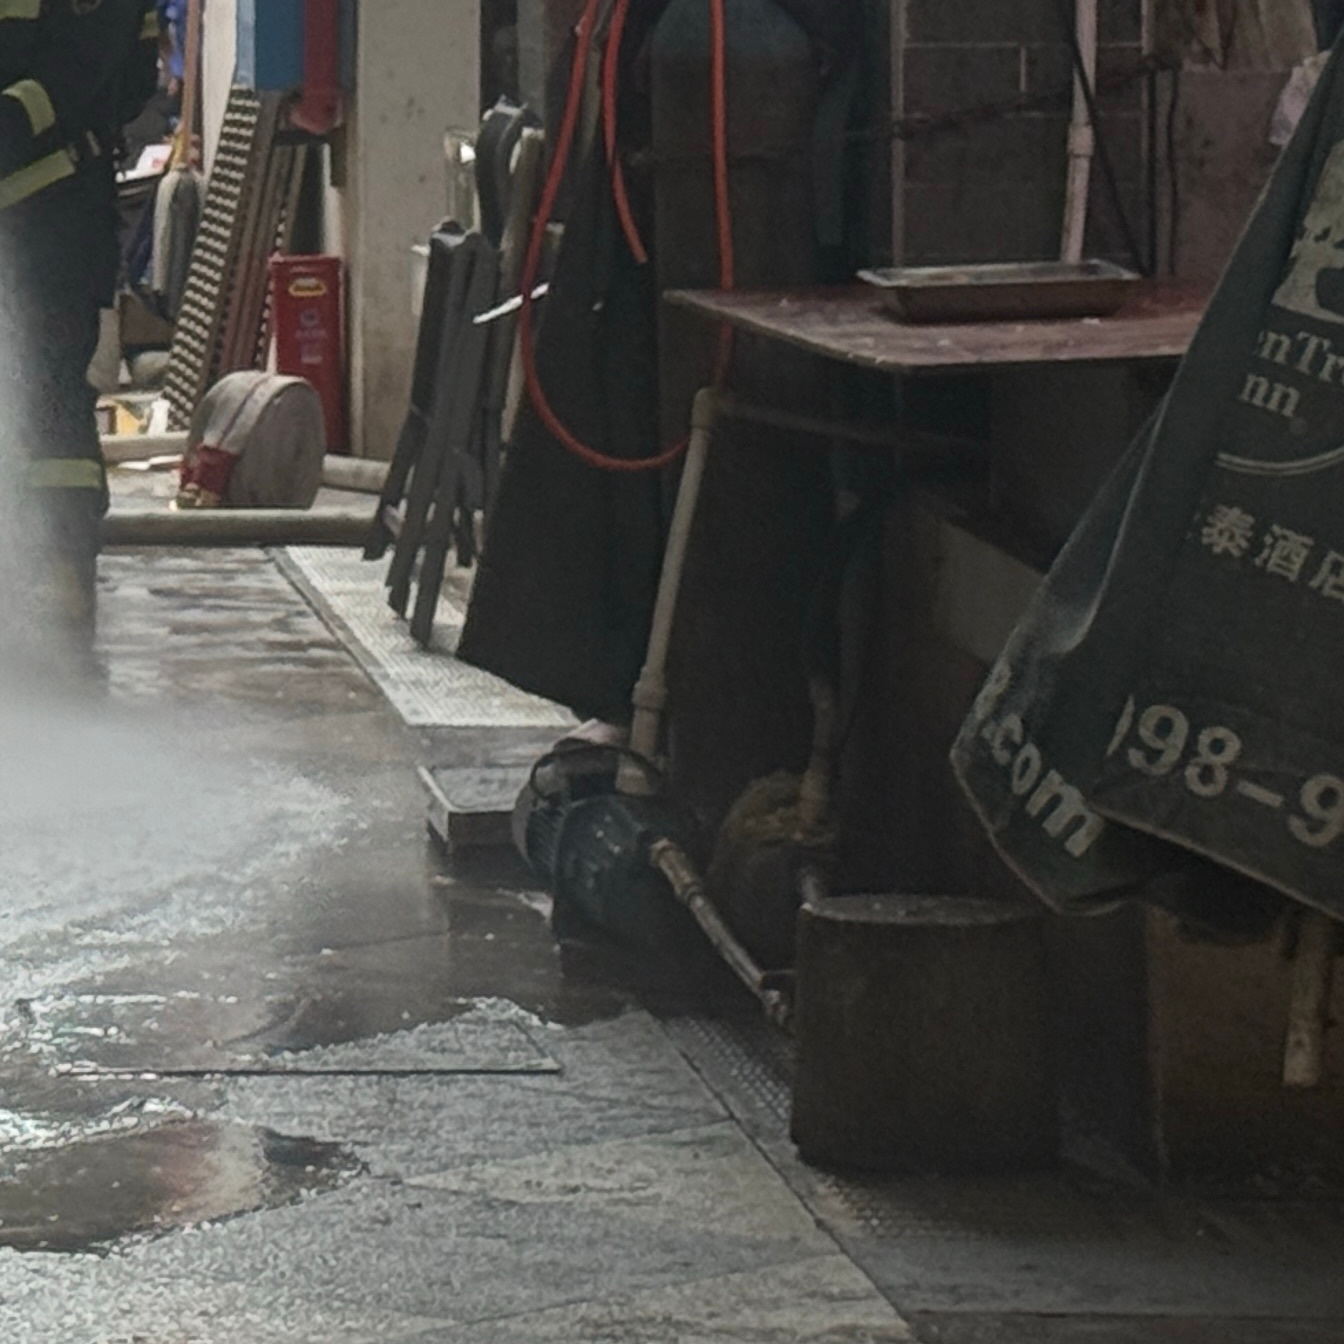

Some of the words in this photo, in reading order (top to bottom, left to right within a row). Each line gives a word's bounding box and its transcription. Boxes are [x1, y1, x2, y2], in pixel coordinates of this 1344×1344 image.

[1253, 329, 1344, 387] nTr
[1188, 503, 1344, 602] 泰酒店
[1105, 693, 1344, 847] 98-9
